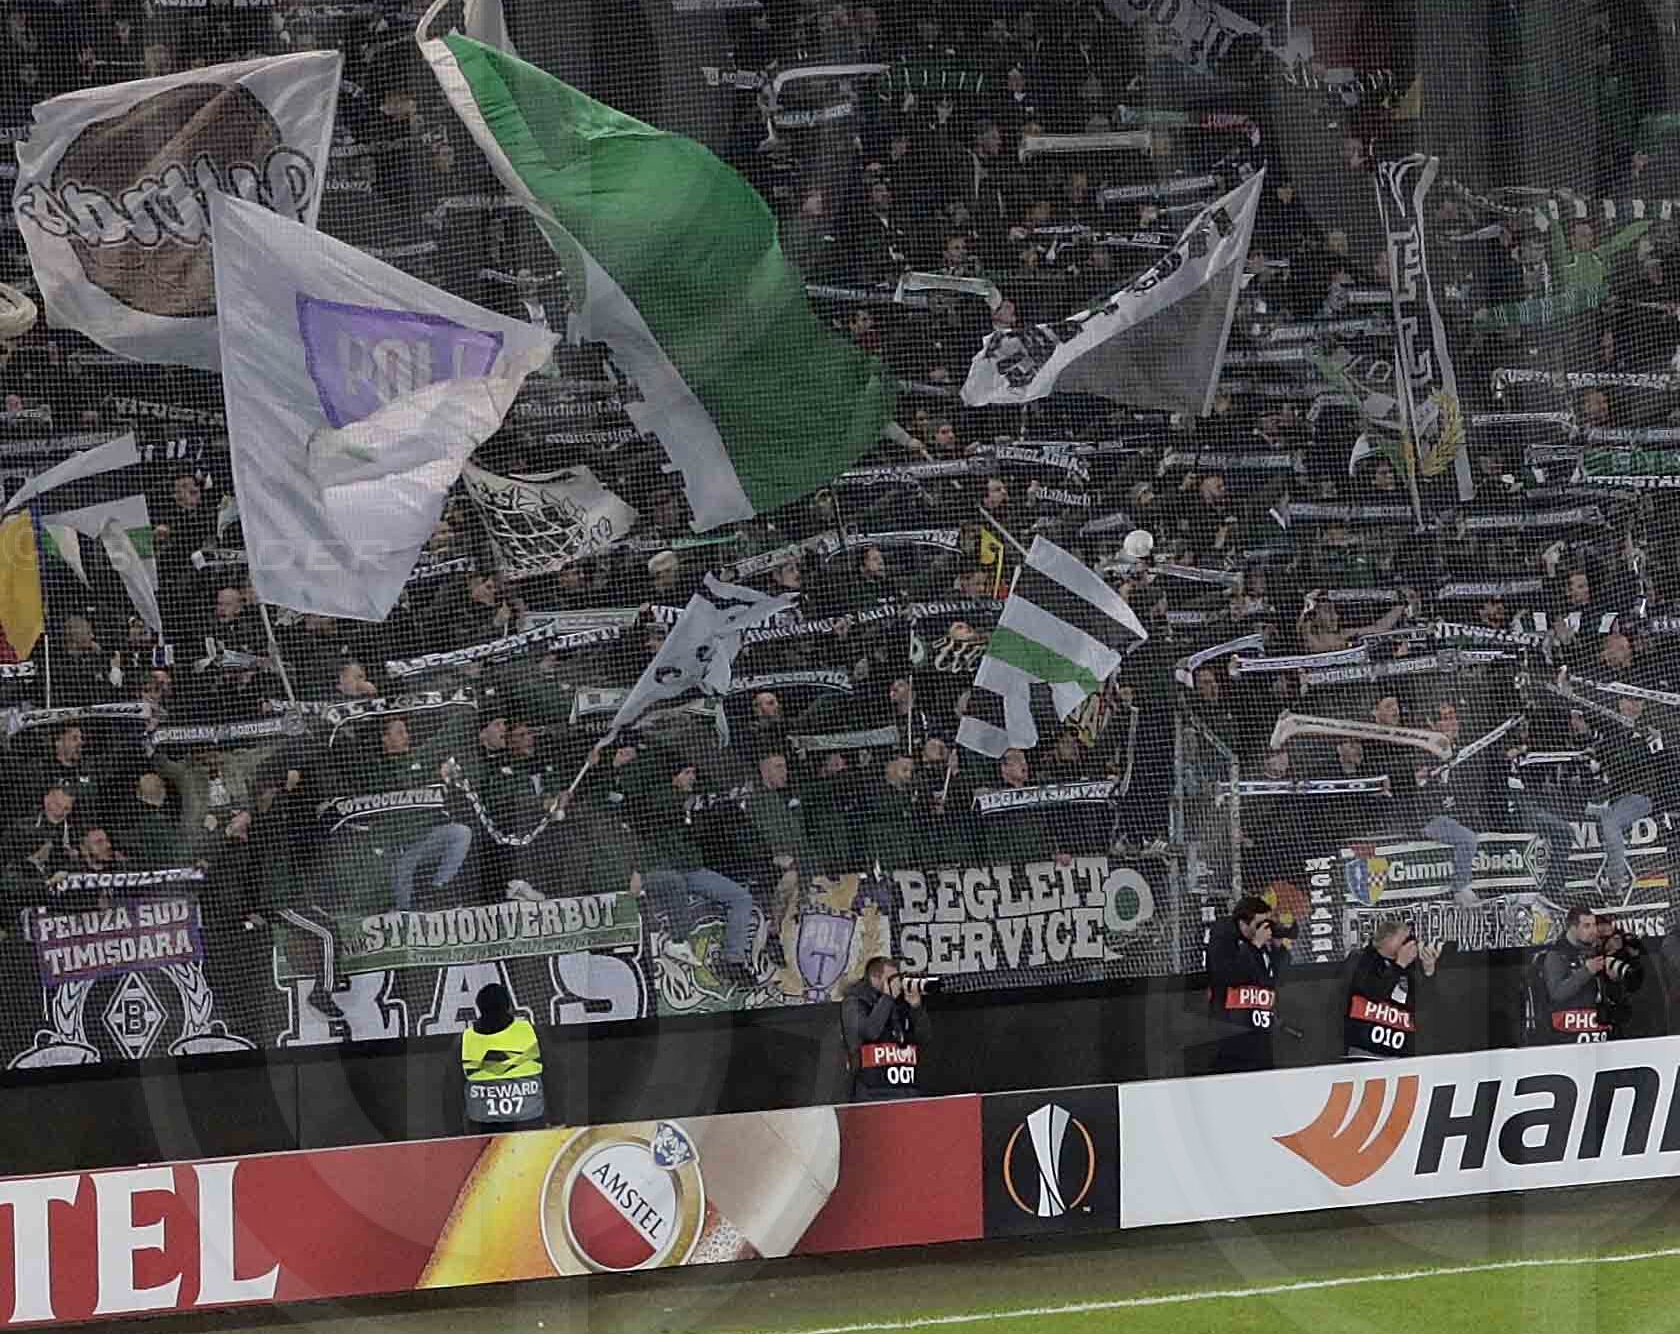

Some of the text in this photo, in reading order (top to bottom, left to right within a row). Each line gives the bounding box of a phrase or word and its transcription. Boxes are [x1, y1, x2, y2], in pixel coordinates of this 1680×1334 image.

[892, 855, 1109, 925] BEGLEIT
[38, 898, 190, 940] PELUZA SUD
[360, 892, 619, 955] STADIONVERBOT
[892, 911, 1106, 980] SERVICE
[1371, 1024, 1405, 1050] 010
[468, 1079, 540, 1101] STEWARD
[485, 1097, 525, 1117] 107
[586, 1158, 671, 1242] AMSTEL
